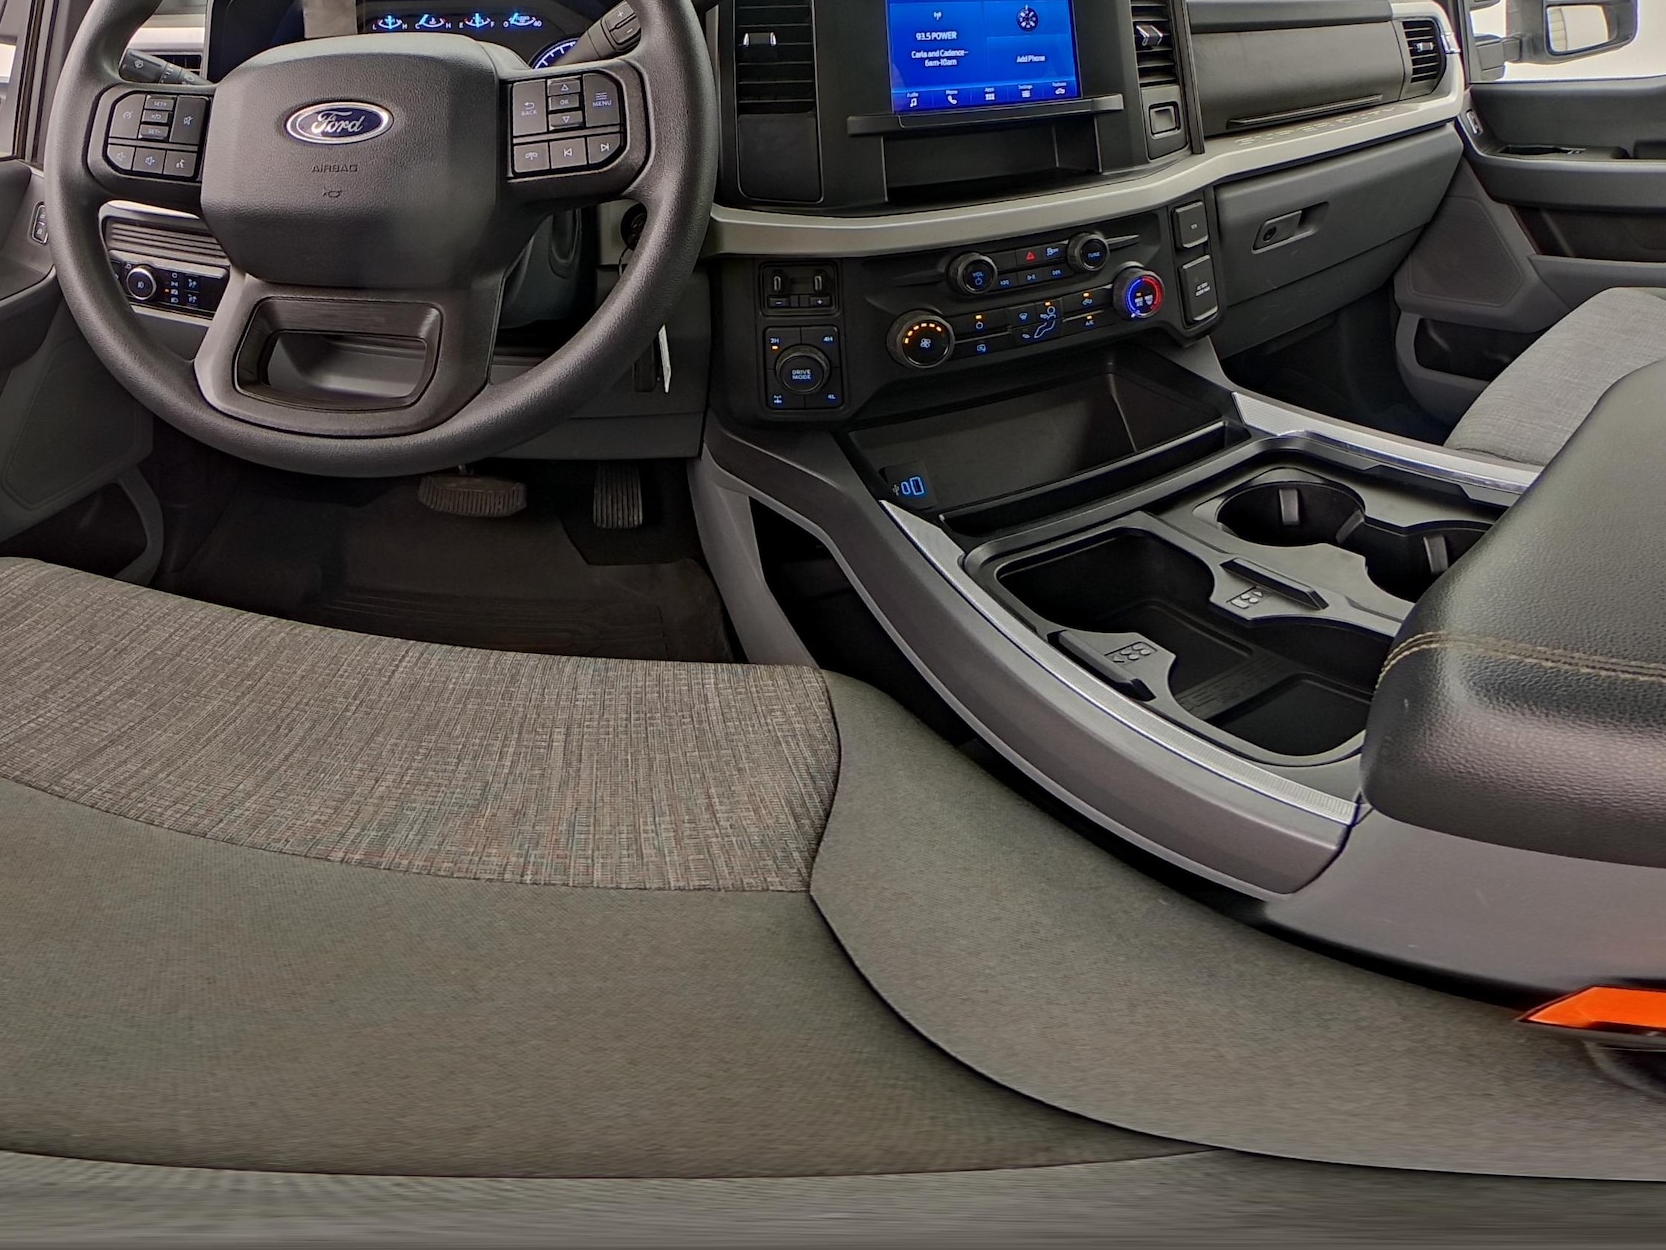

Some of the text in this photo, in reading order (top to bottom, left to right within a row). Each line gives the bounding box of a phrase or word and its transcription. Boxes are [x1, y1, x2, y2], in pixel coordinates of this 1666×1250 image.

[916, 31, 957, 41] 93.5 POWER
[1017, 54, 1045, 63] Add Phone
[311, 111, 366, 134] Ford
[311, 164, 358, 173] AIRBAG
